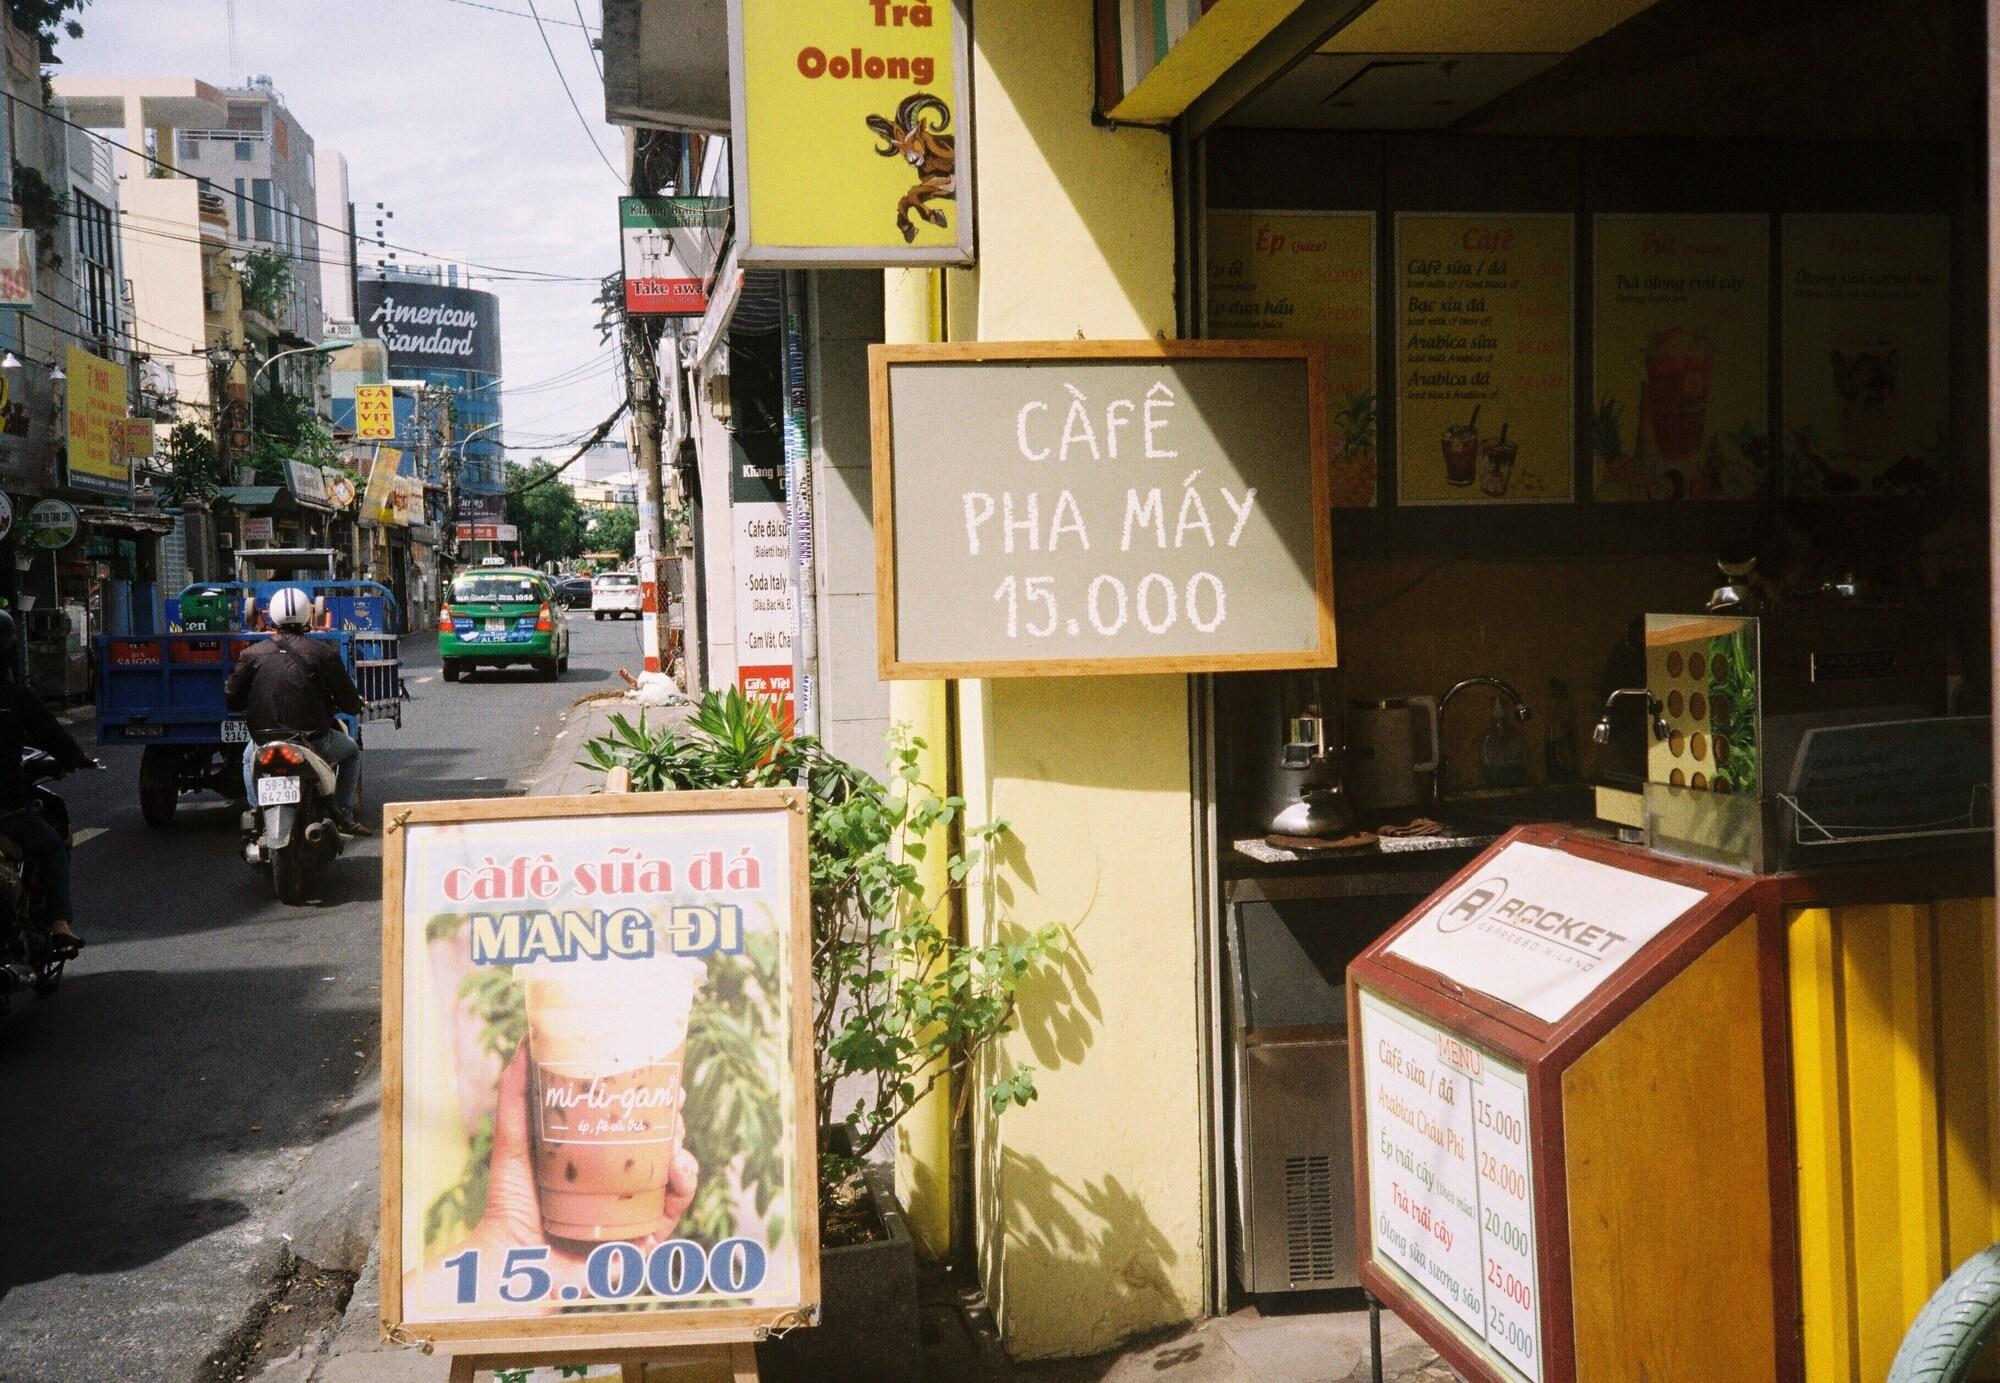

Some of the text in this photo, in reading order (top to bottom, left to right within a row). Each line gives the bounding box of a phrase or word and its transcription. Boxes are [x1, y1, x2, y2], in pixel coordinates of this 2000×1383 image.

[797, 46, 934, 85] Oolong
[1256, 222, 1285, 255] Ép
[633, 281, 669, 296] Take
[1476, 260, 1485, 276] /
[370, 296, 477, 328] American
[1466, 296, 1485, 312] đá
[1408, 333, 1467, 350] Arabica
[1408, 371, 1467, 387] Arabica
[360, 401, 388, 409] TA
[1017, 381, 1179, 462] CÀFÊ
[743, 464, 773, 479] Khang
[963, 469, 1258, 556] PHA MÁY
[749, 573, 786, 594] Soda Italy
[993, 571, 1226, 639] 15.000
[749, 632, 763, 649] Cam
[573, 845, 673, 897] sữa
[471, 904, 745, 966] MANG ĐI
[1496, 897, 1627, 953] ROCKET
[1438, 1033, 1481, 1076] MENU
[1429, 1069, 1435, 1095] /
[1478, 1100, 1521, 1145] 15.000
[1379, 1083, 1525, 1201] Arabica Châu Phi 28.000
[1381, 1126, 1393, 1159] Ép
[1395, 1145, 1415, 1173] trái
[1417, 1159, 1435, 1193] cây
[1485, 1207, 1528, 1257] 20.000
[1392, 1181, 1531, 1311] Trà trái cây 25.000
[443, 1237, 768, 1304] 15.000
[1463, 1285, 1481, 1314] sáo
[1490, 1305, 1533, 1359] 25.000
